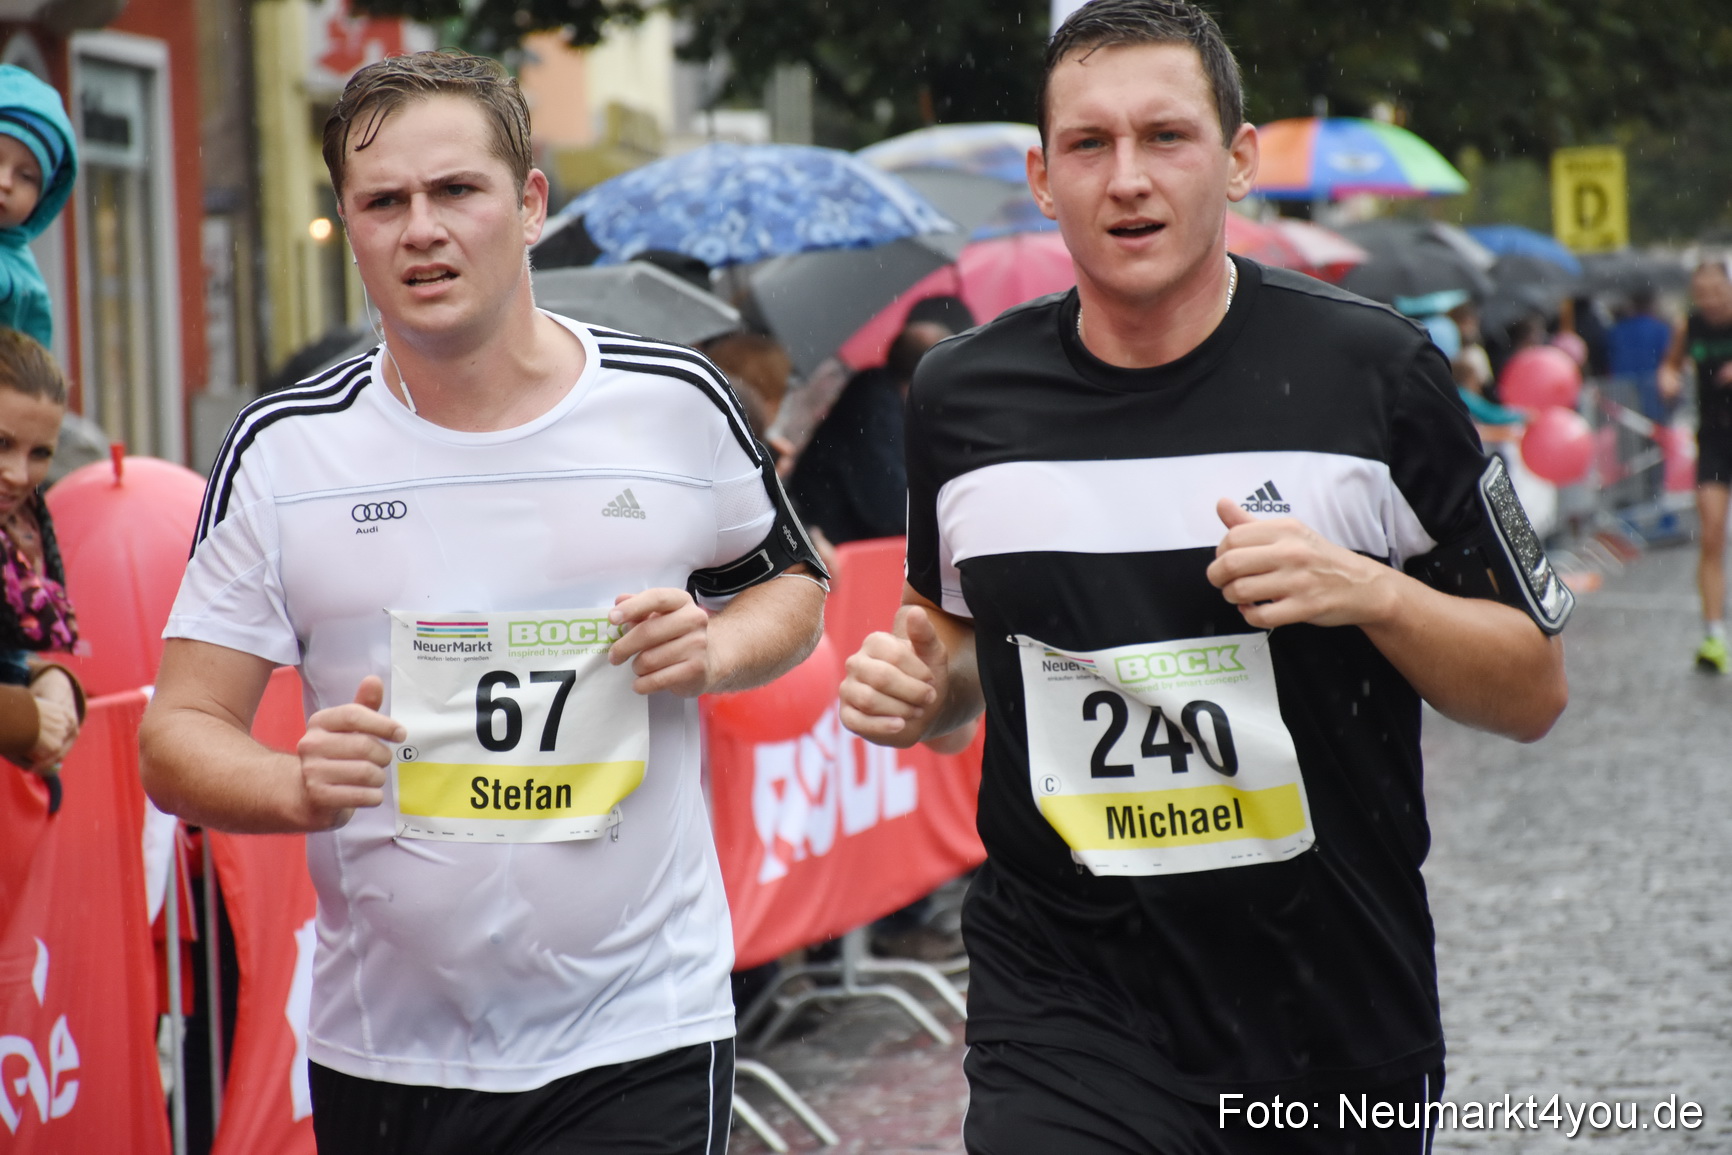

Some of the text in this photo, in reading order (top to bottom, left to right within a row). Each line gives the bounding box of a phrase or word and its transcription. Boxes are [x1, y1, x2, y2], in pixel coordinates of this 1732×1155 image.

[1573, 181, 1610, 232] D
[601, 505, 646, 520] adidas
[1240, 498, 1291, 514] adidas
[355, 525, 379, 535] Audi
[413, 639, 493, 653] NeuerMarkt
[508, 648, 545, 659] inspired
[547, 647, 559, 657] by
[561, 647, 588, 656] smart
[1114, 644, 1246, 684] BOCK
[1204, 674, 1249, 686] concepts
[475, 669, 577, 753] 67
[1082, 690, 1239, 779] 240
[470, 776, 573, 811] Stefan
[1106, 797, 1244, 840] Michael
